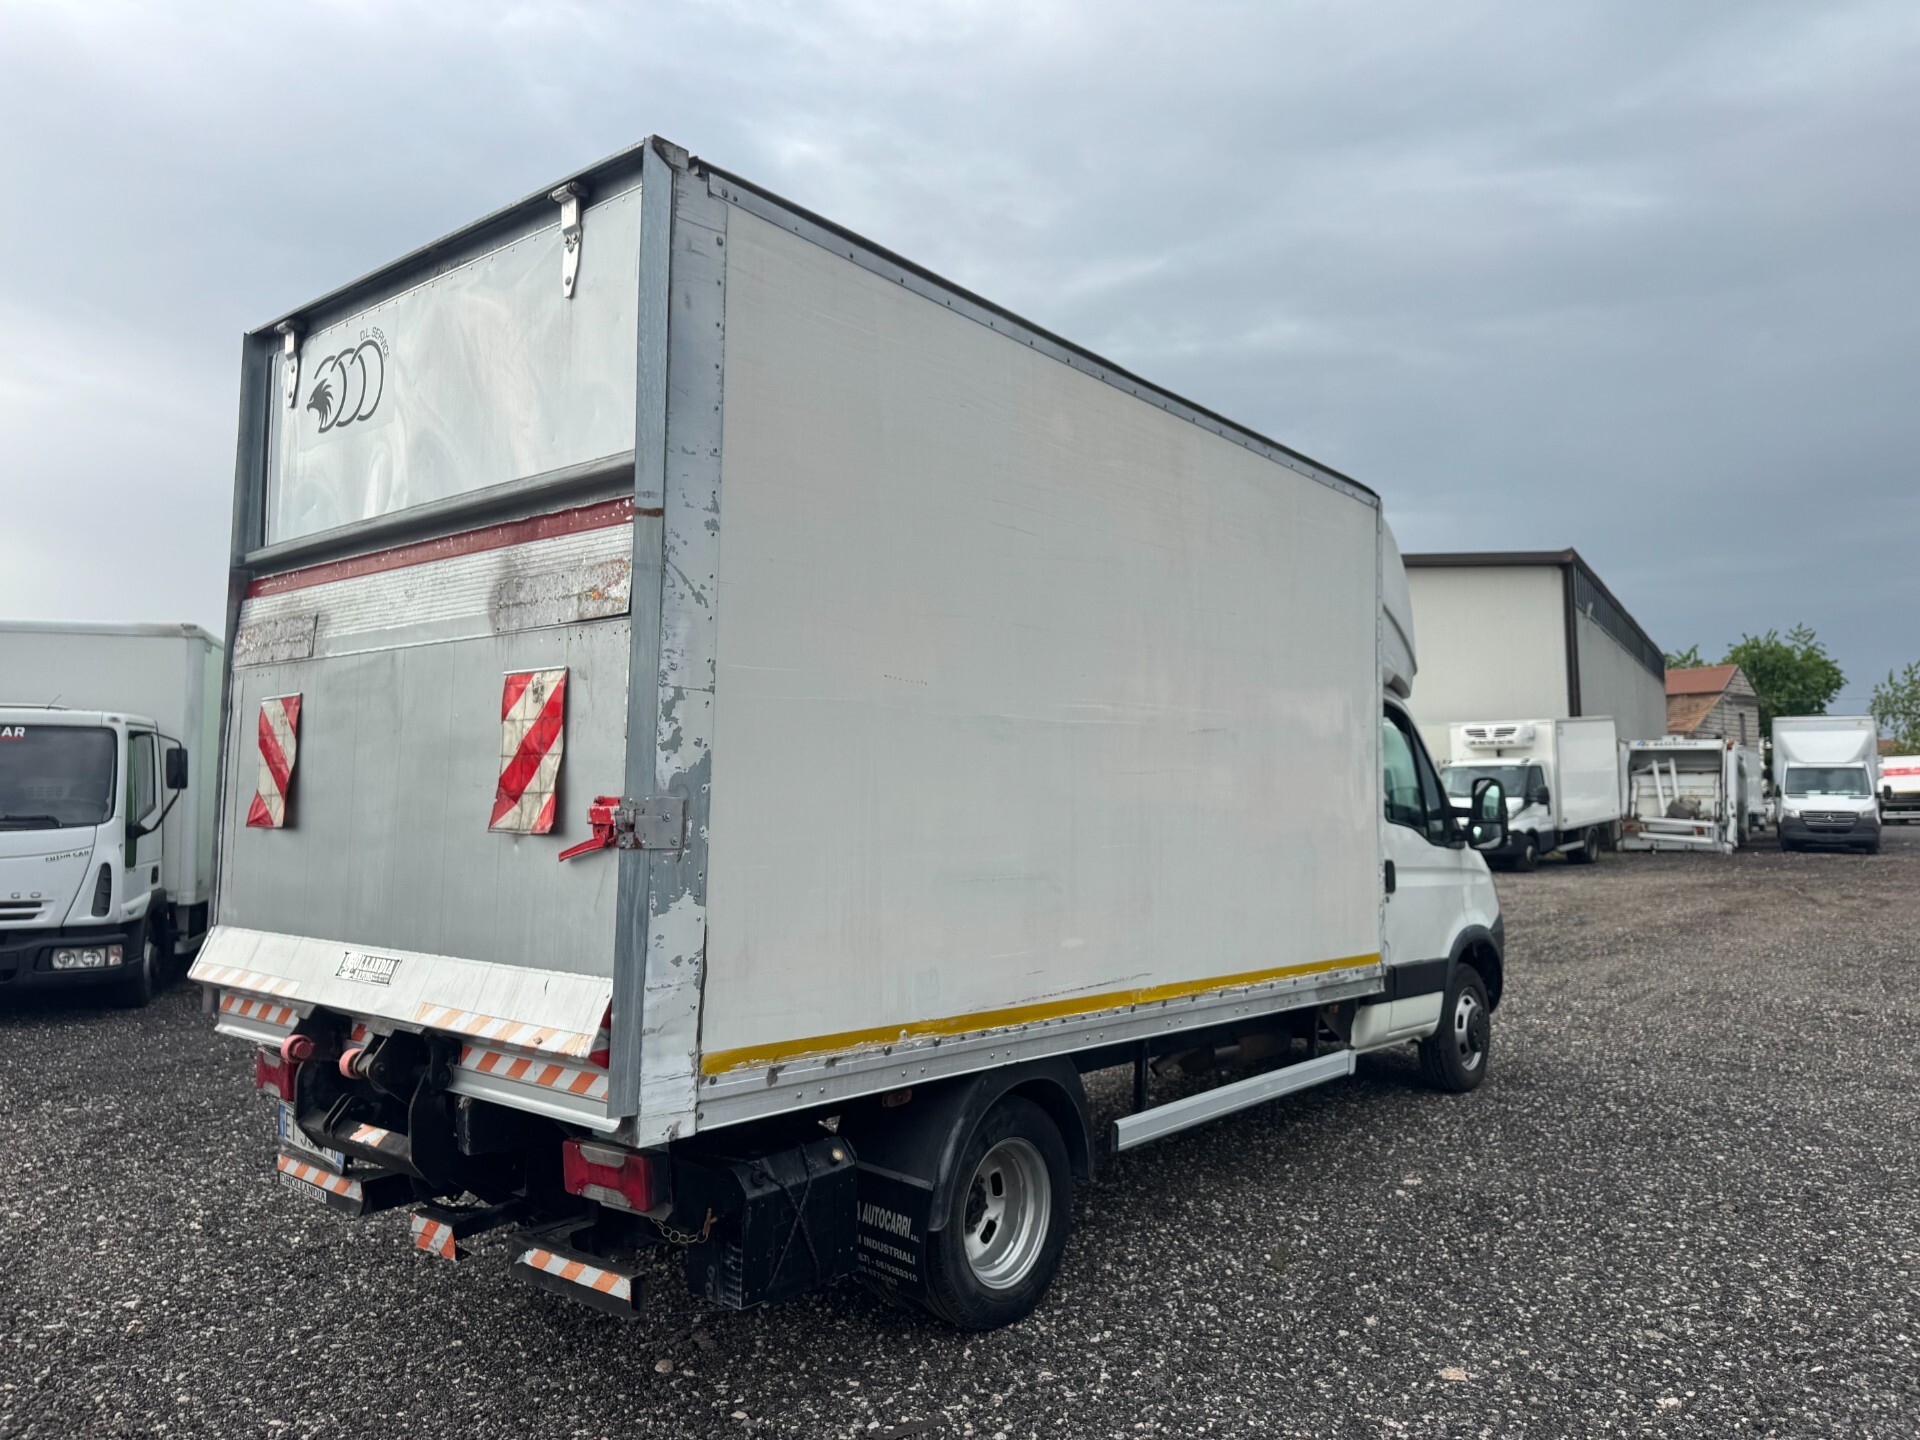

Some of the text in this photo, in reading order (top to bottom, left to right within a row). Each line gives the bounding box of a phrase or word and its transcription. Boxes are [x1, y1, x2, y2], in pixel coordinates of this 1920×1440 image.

[371, 326, 390, 362] SERVICE
[0, 726, 25, 738] AR
[280, 1173, 326, 1201] DHOLLANDIA
[862, 1202, 911, 1239] AUTOCARRI
[863, 1236, 915, 1265] INDUSTRIALI
